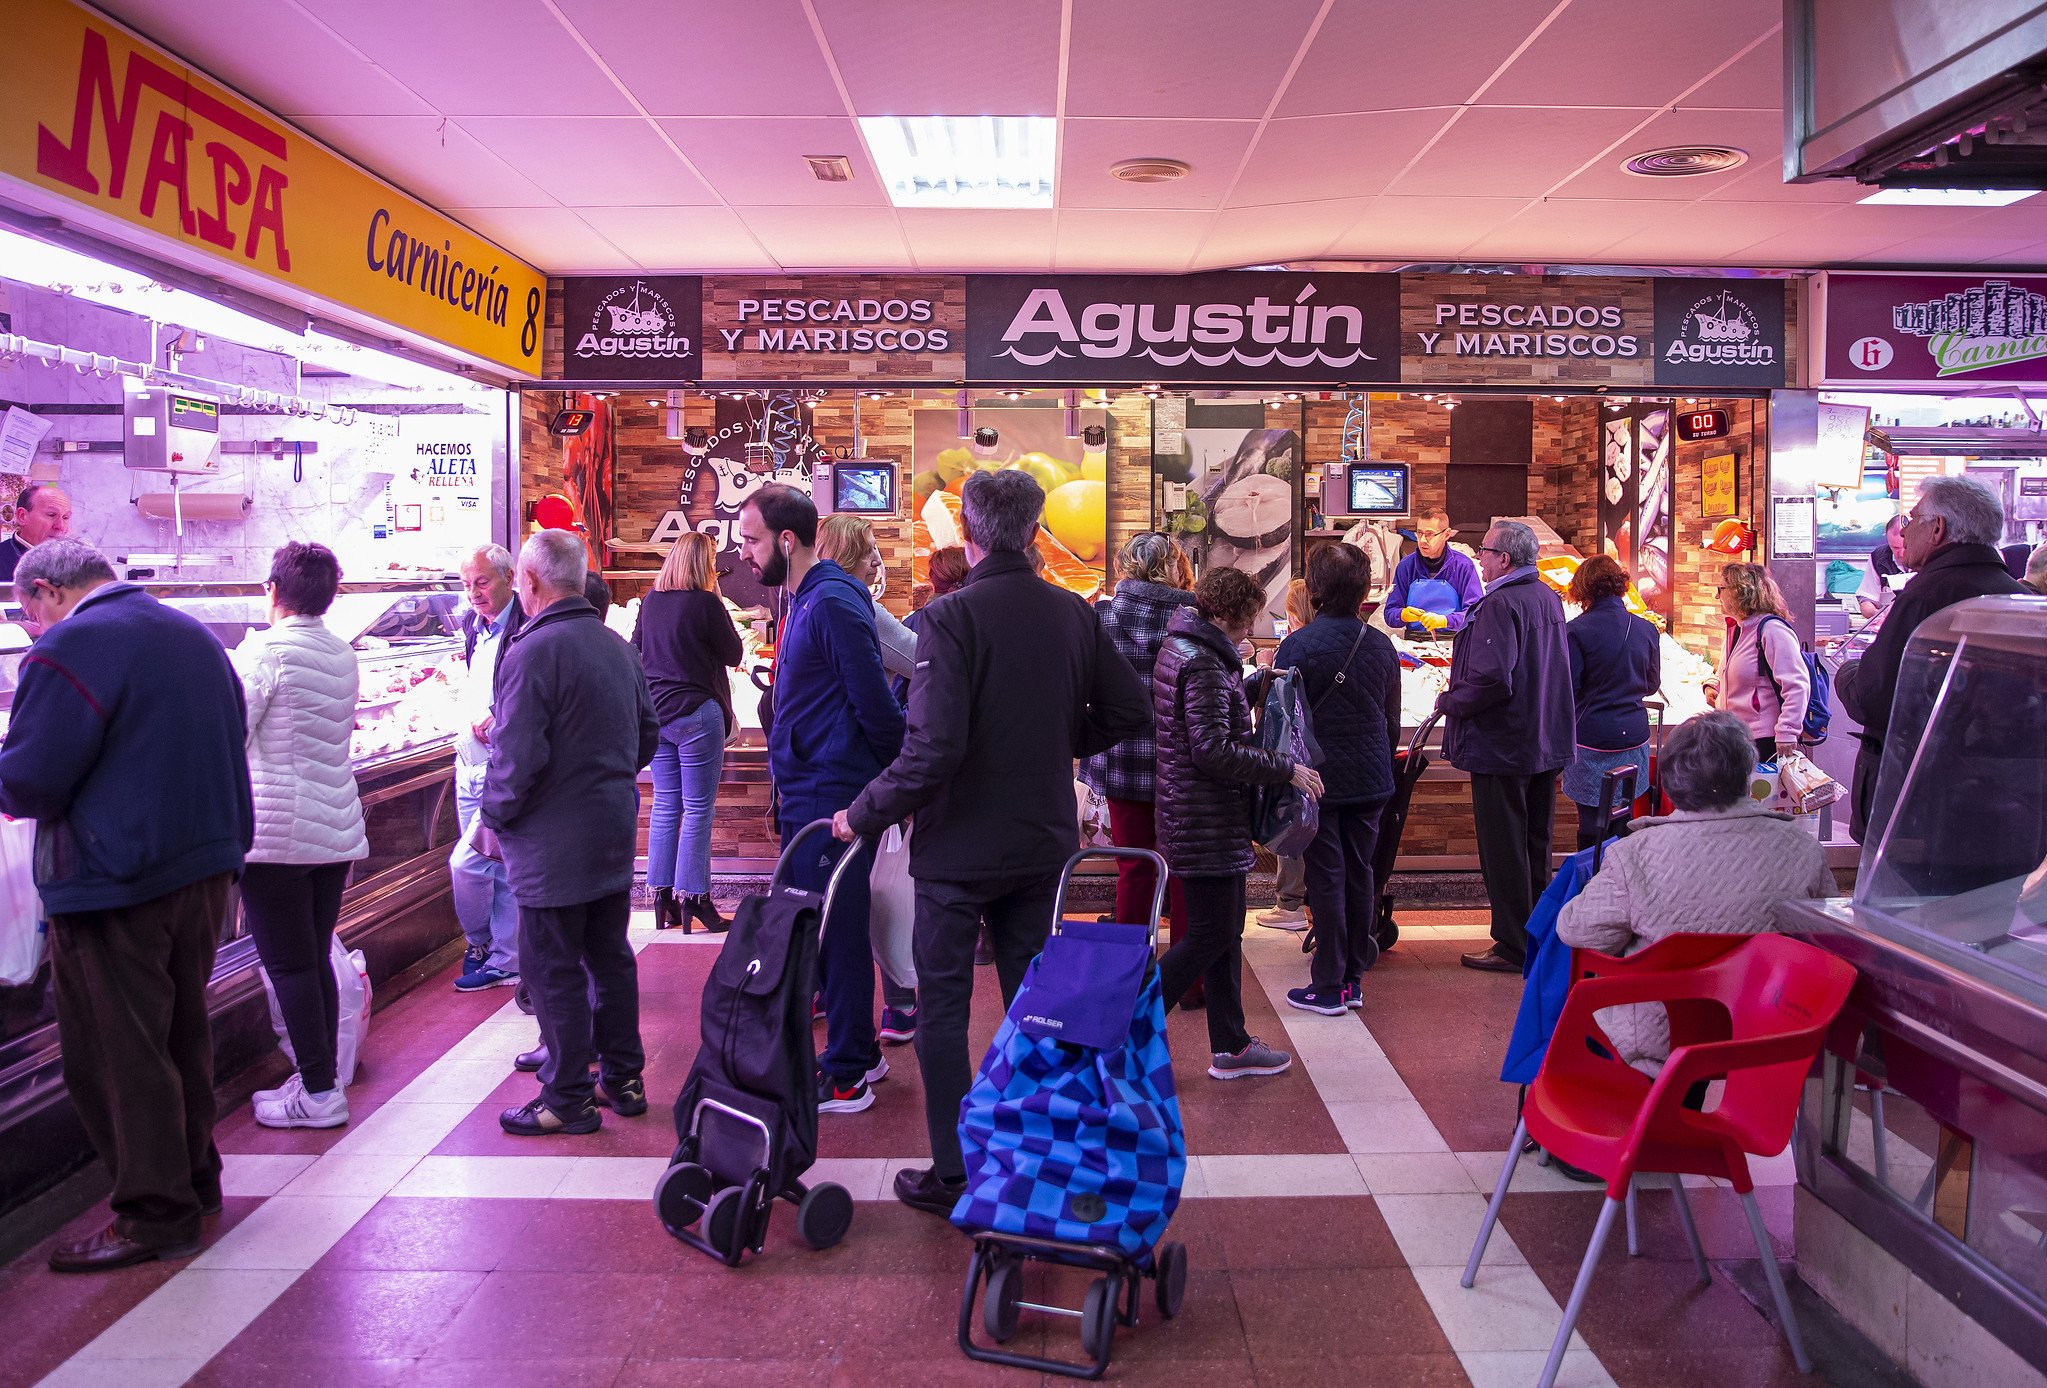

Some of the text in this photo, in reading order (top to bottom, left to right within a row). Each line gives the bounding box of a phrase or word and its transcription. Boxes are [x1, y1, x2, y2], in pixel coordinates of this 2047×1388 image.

[37, 26, 291, 272] NAPA
[366, 208, 541, 358] Carnicería 8
[592, 287, 626, 331] PESCADOS
[640, 286, 676, 328] MARISCOS
[737, 299, 933, 322] PESCADOS
[1000, 283, 1364, 358] Agustín
[1435, 303, 1622, 327] PESCADOS
[1681, 296, 1712, 337] PESCADOS
[1726, 295, 1760, 336] MARISCOS
[575, 330, 690, 356] Agustín
[720, 328, 949, 352] Y MARISCOS
[1418, 332, 1638, 357] Y MARISCOS
[1665, 338, 1773, 362] Agustín
[1930, 328, 2047, 367] Carnic
[568, 414, 584, 426] 13
[1692, 414, 1713, 429] 00
[416, 443, 471, 455] HACEMOS
[426, 458, 477, 475] ALETA
[681, 422, 743, 505] PESCDOS
[461, 500, 477, 508] VISA
[1031, 1015, 1064, 1029] ROLSER
